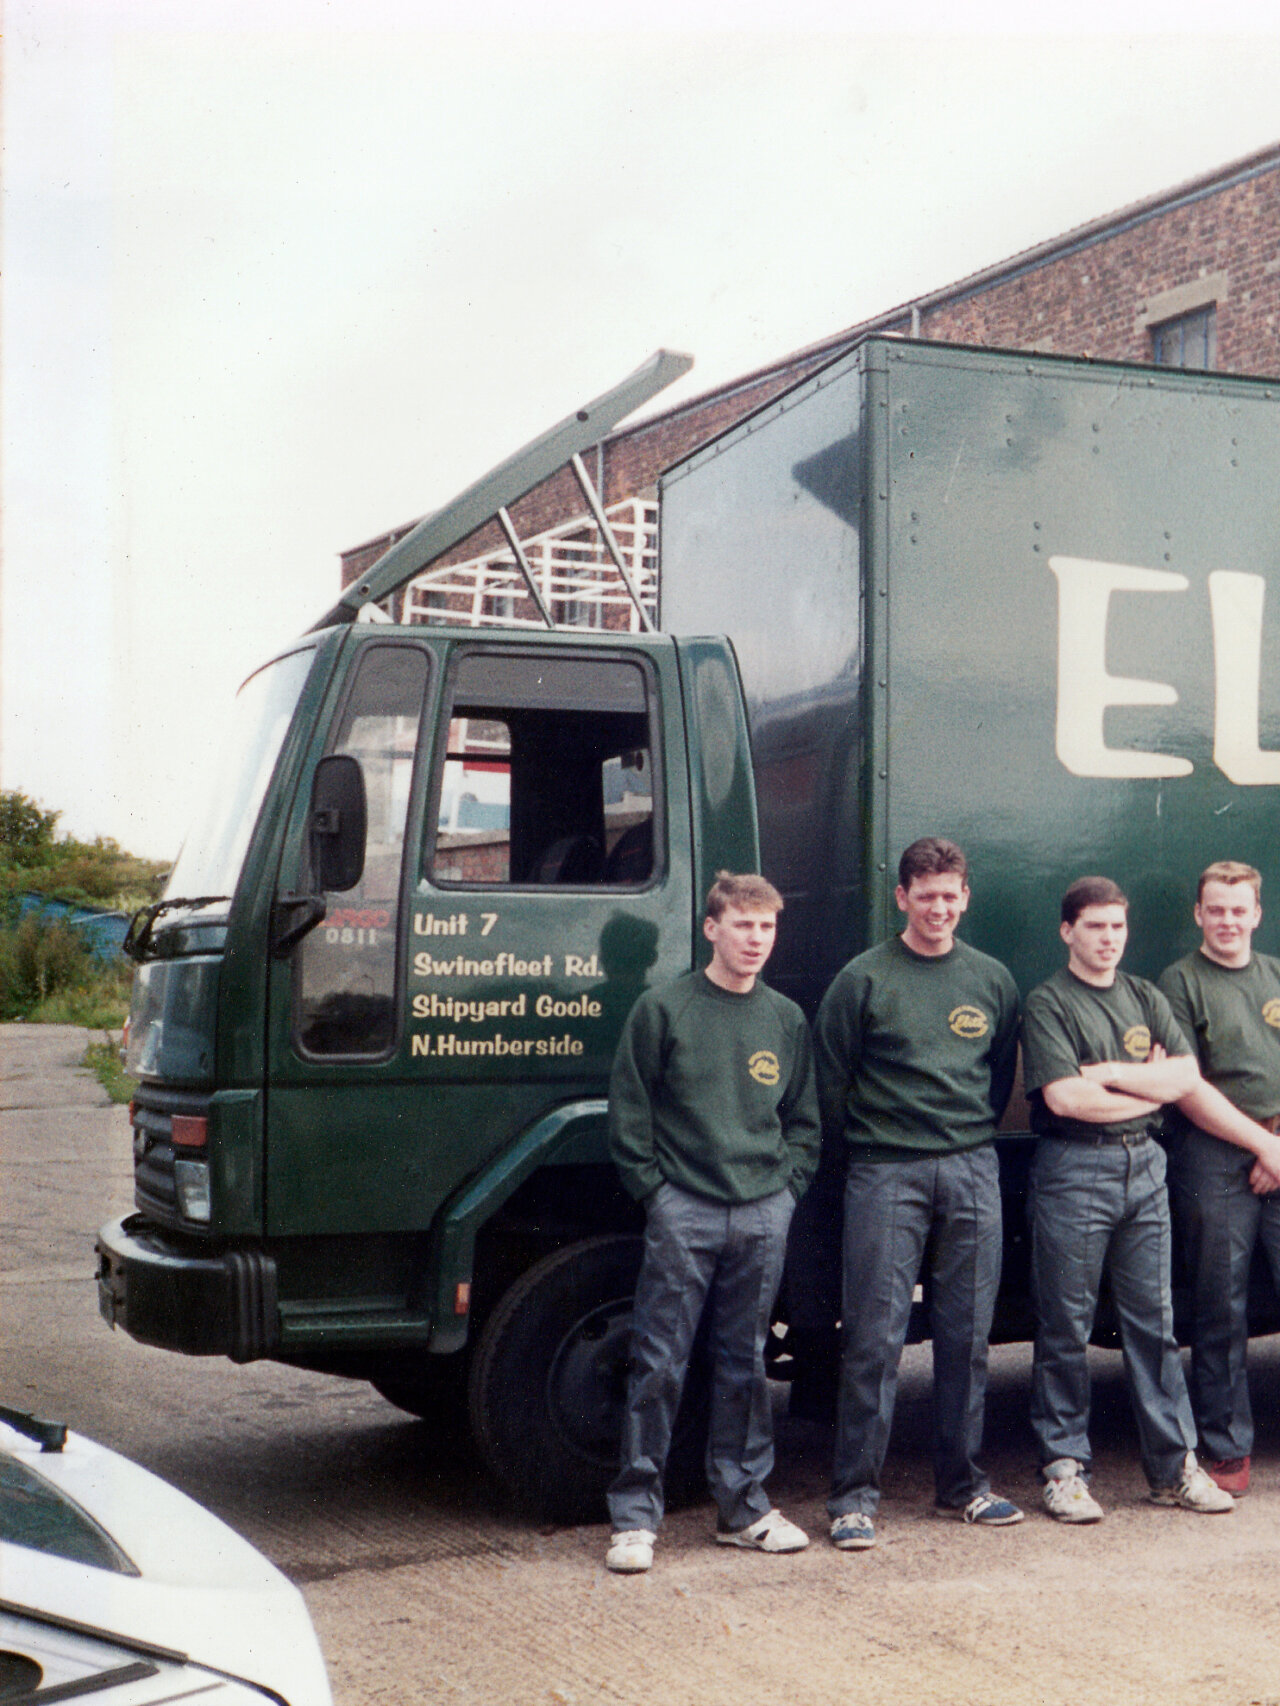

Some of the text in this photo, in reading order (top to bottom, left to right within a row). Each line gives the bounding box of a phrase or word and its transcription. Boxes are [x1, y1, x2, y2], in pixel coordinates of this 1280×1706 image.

[318, 908, 391, 929] ARGO
[413, 912, 499, 936] Unit 7
[325, 927, 378, 945] 0811
[413, 952, 605, 977] Swinefleet Rd.
[411, 993, 603, 1023] Shipyard Goole
[411, 1033, 584, 1057] N.Humberside
